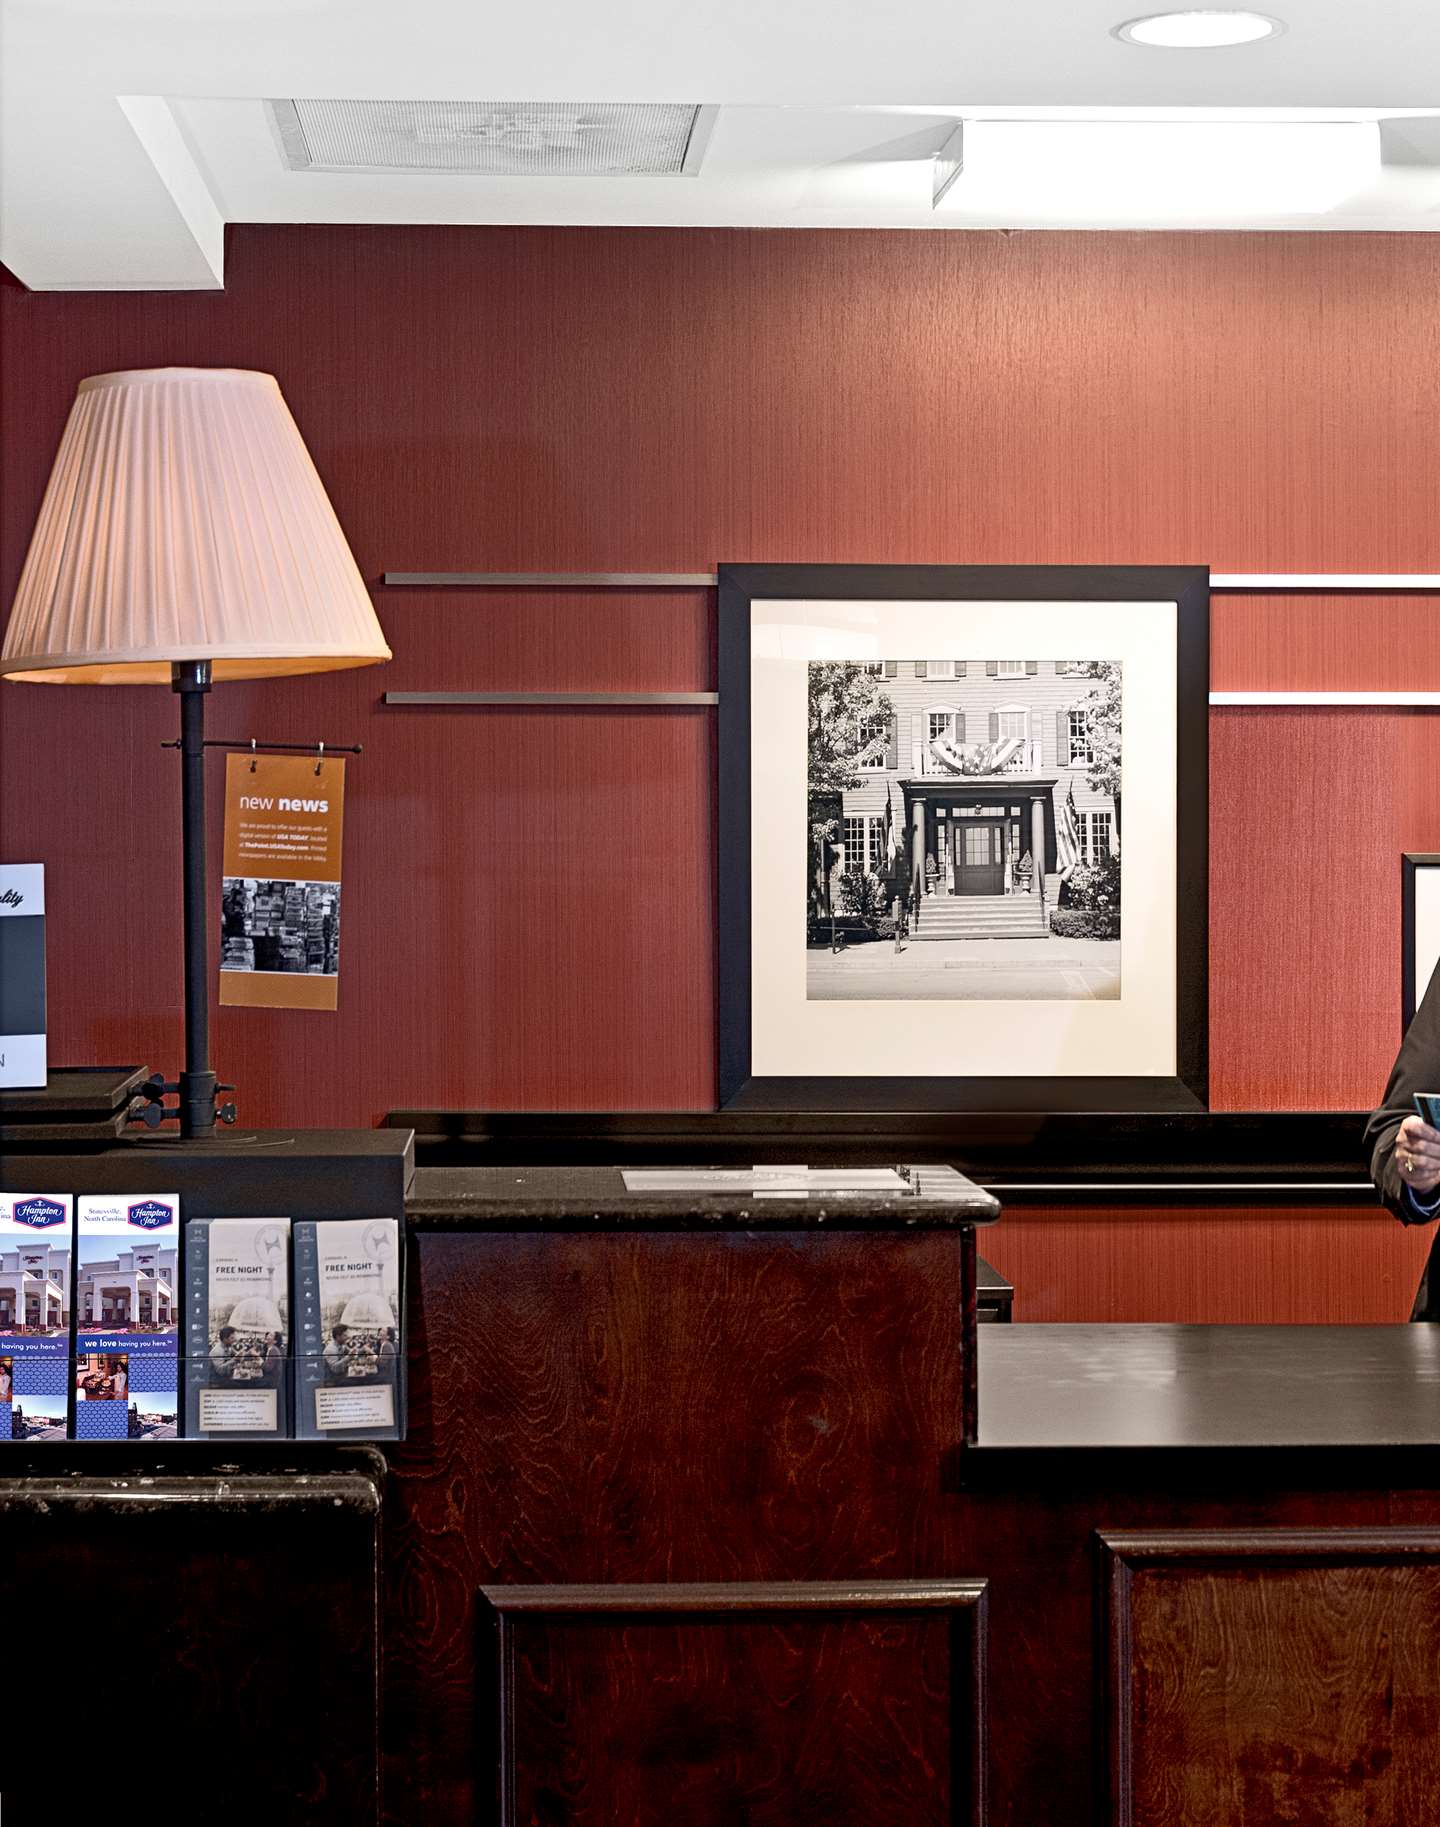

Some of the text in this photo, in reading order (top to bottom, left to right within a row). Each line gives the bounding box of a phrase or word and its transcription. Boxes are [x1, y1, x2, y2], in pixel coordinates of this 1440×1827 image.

[240, 796, 328, 813] new news
[17, 1204, 62, 1216] Hampton
[131, 1207, 170, 1218] Hampton
[28, 1215, 50, 1226] Inn
[140, 1217, 160, 1226] Inn
[348, 1263, 372, 1271] NIGHT
[1, 1342, 24, 1351] having
[100, 1339, 116, 1347] love
